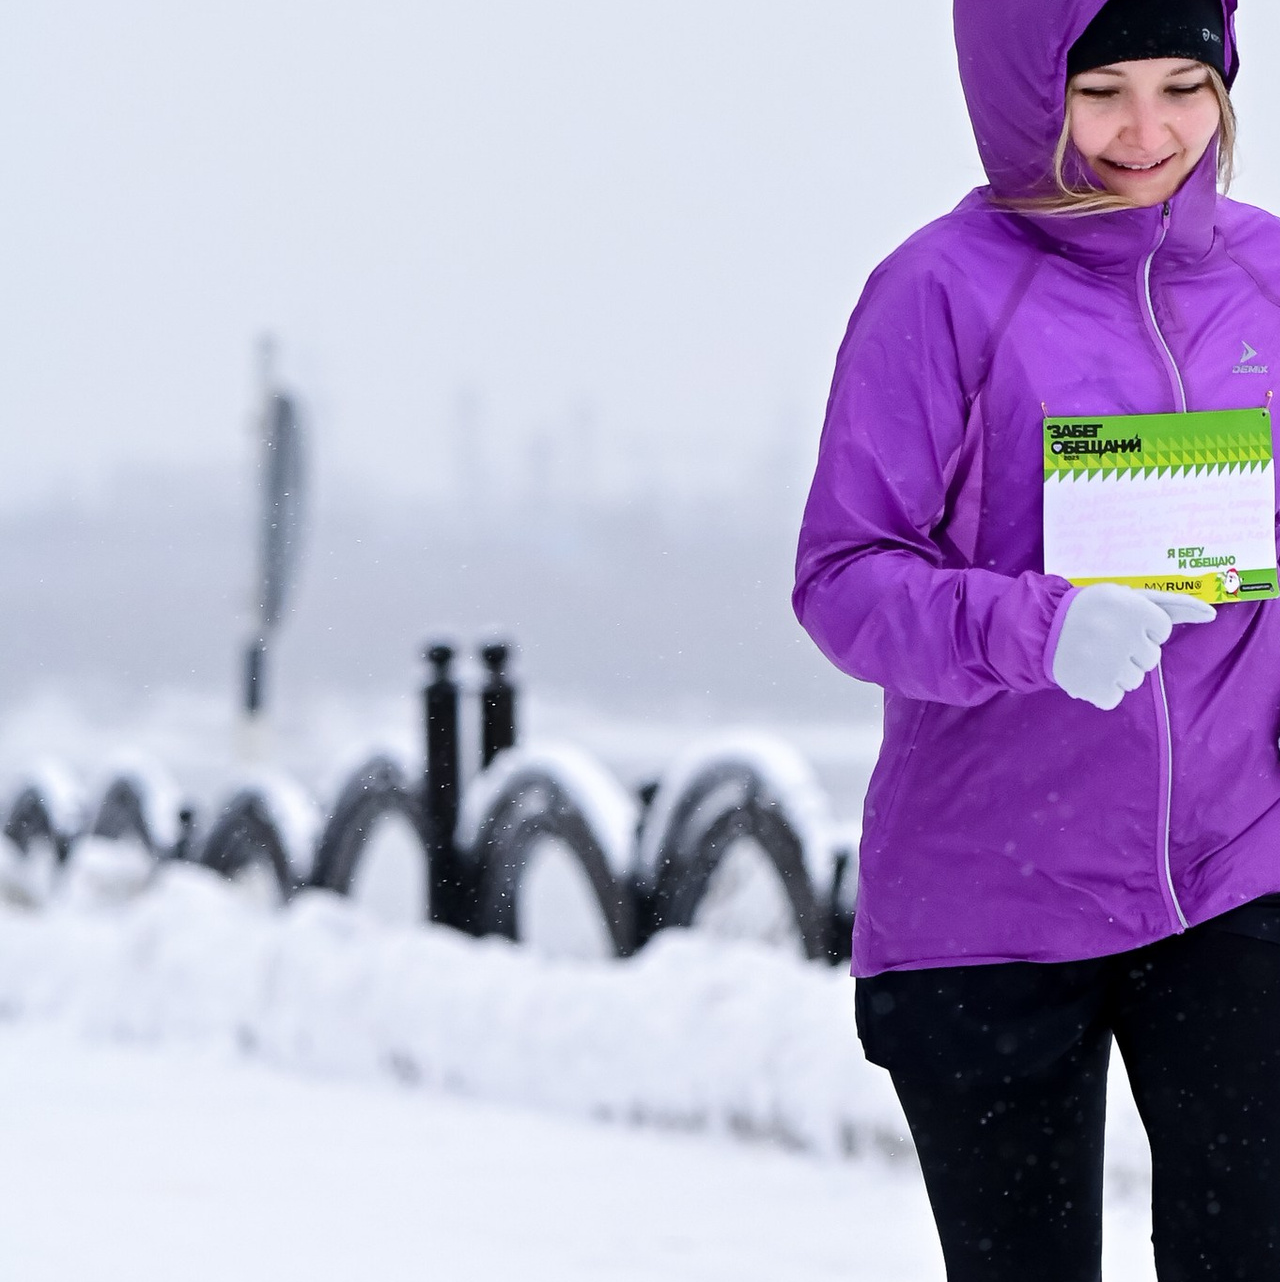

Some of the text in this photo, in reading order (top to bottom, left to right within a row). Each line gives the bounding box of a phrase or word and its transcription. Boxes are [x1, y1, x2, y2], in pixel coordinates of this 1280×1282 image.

[1232, 365, 1268, 374] DEMIX
[1047, 424, 1103, 438] ЗАБЕГ
[1051, 434, 1141, 459] ОБЕЩАНИЙ
[1167, 547, 1204, 558] Я БЕГУ
[1178, 556, 1236, 569] И ОБЕЩАЮ
